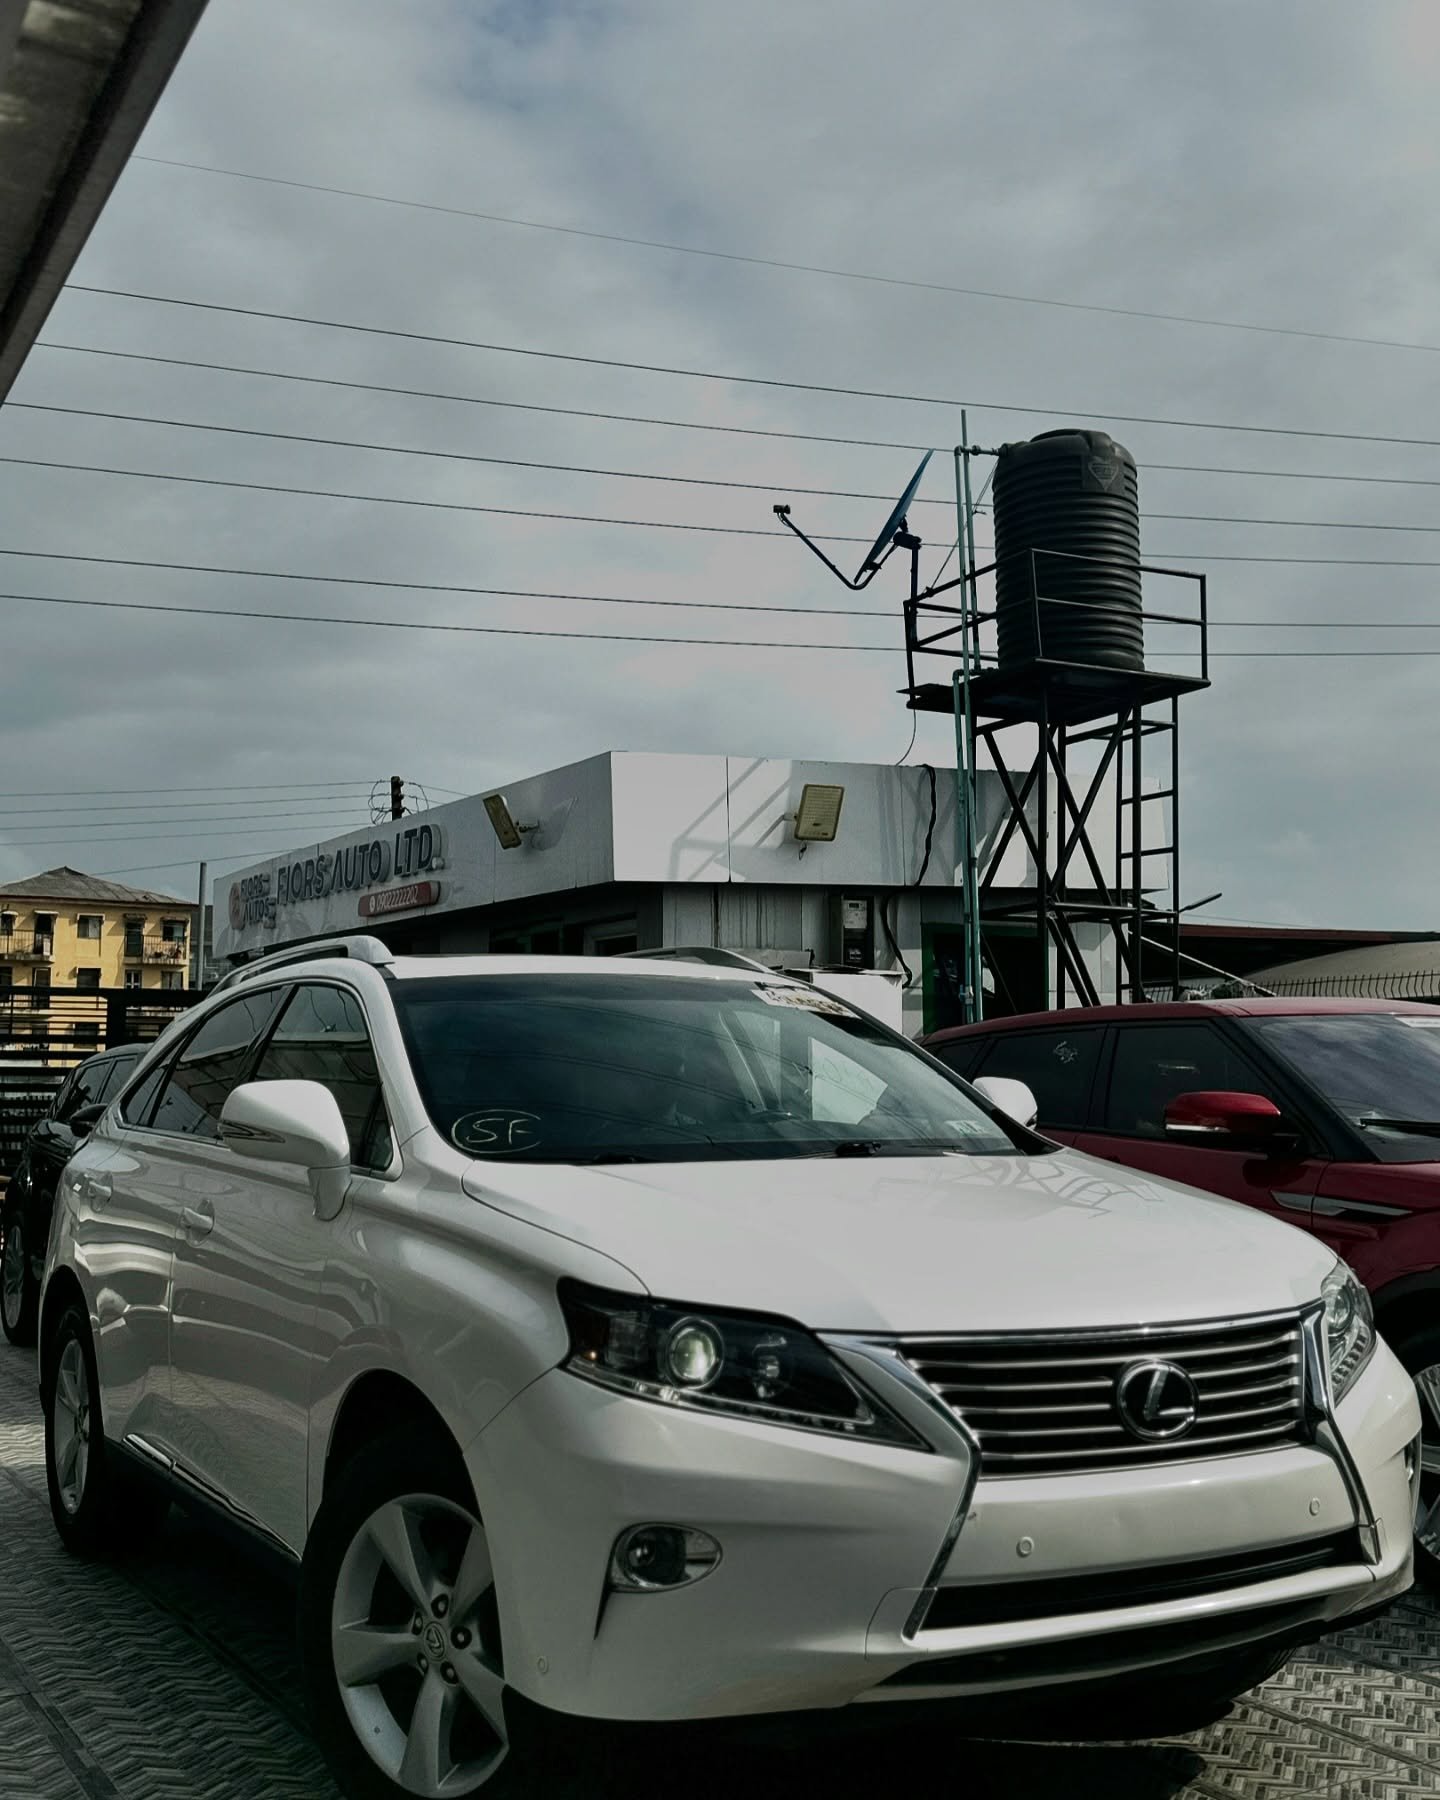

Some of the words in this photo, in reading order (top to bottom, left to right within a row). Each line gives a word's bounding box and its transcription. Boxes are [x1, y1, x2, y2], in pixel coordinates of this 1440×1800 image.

[277, 854, 329, 905] FIORS
[331, 839, 387, 891] AUTO
[465, 1117, 534, 1145] SF
